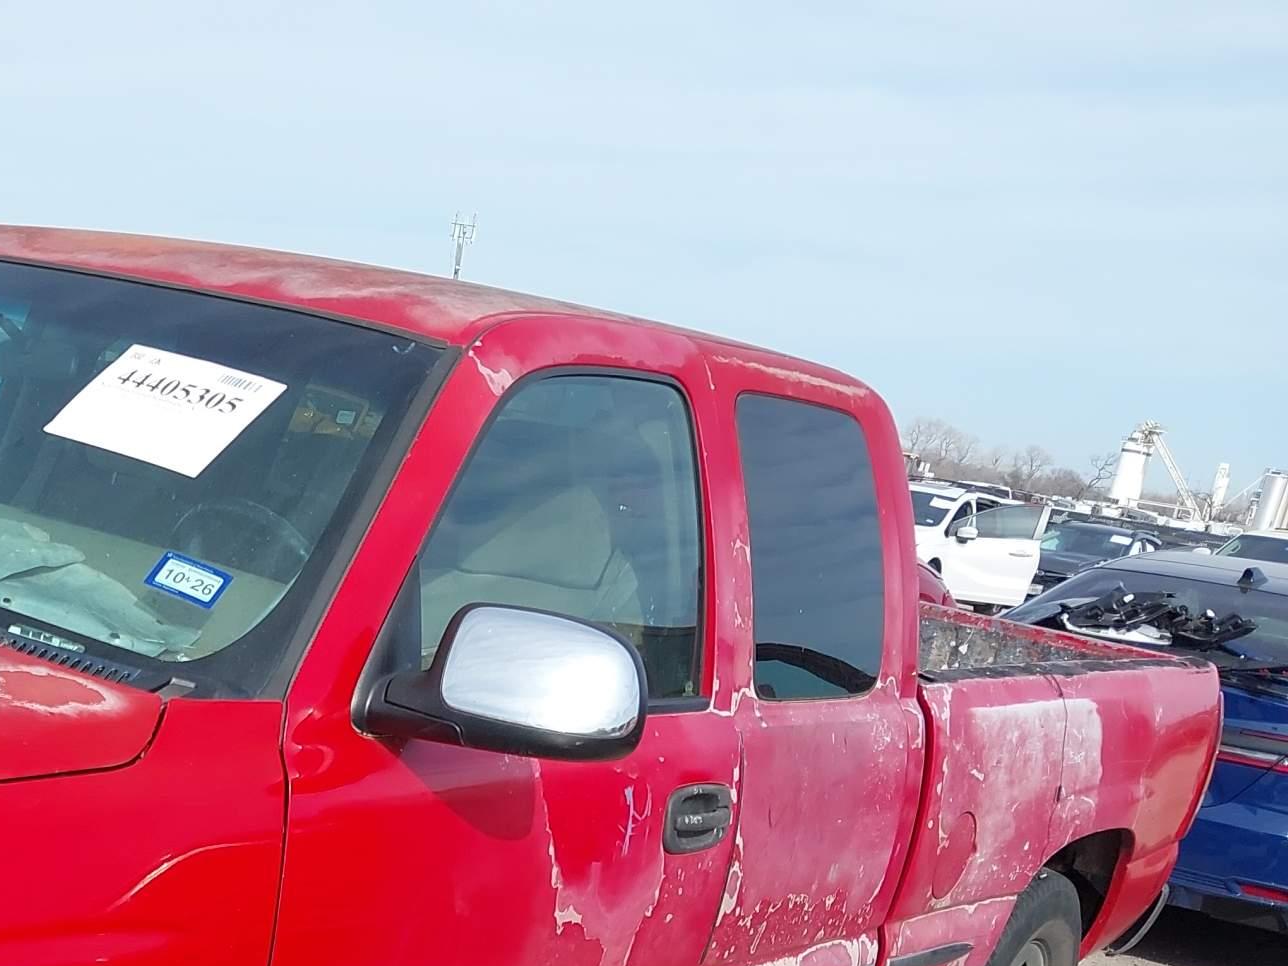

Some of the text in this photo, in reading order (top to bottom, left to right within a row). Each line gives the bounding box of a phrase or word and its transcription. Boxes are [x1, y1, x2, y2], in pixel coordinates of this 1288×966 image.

[117, 369, 244, 414] 44405305
[164, 569, 186, 584] 10
[189, 578, 215, 596] 26
